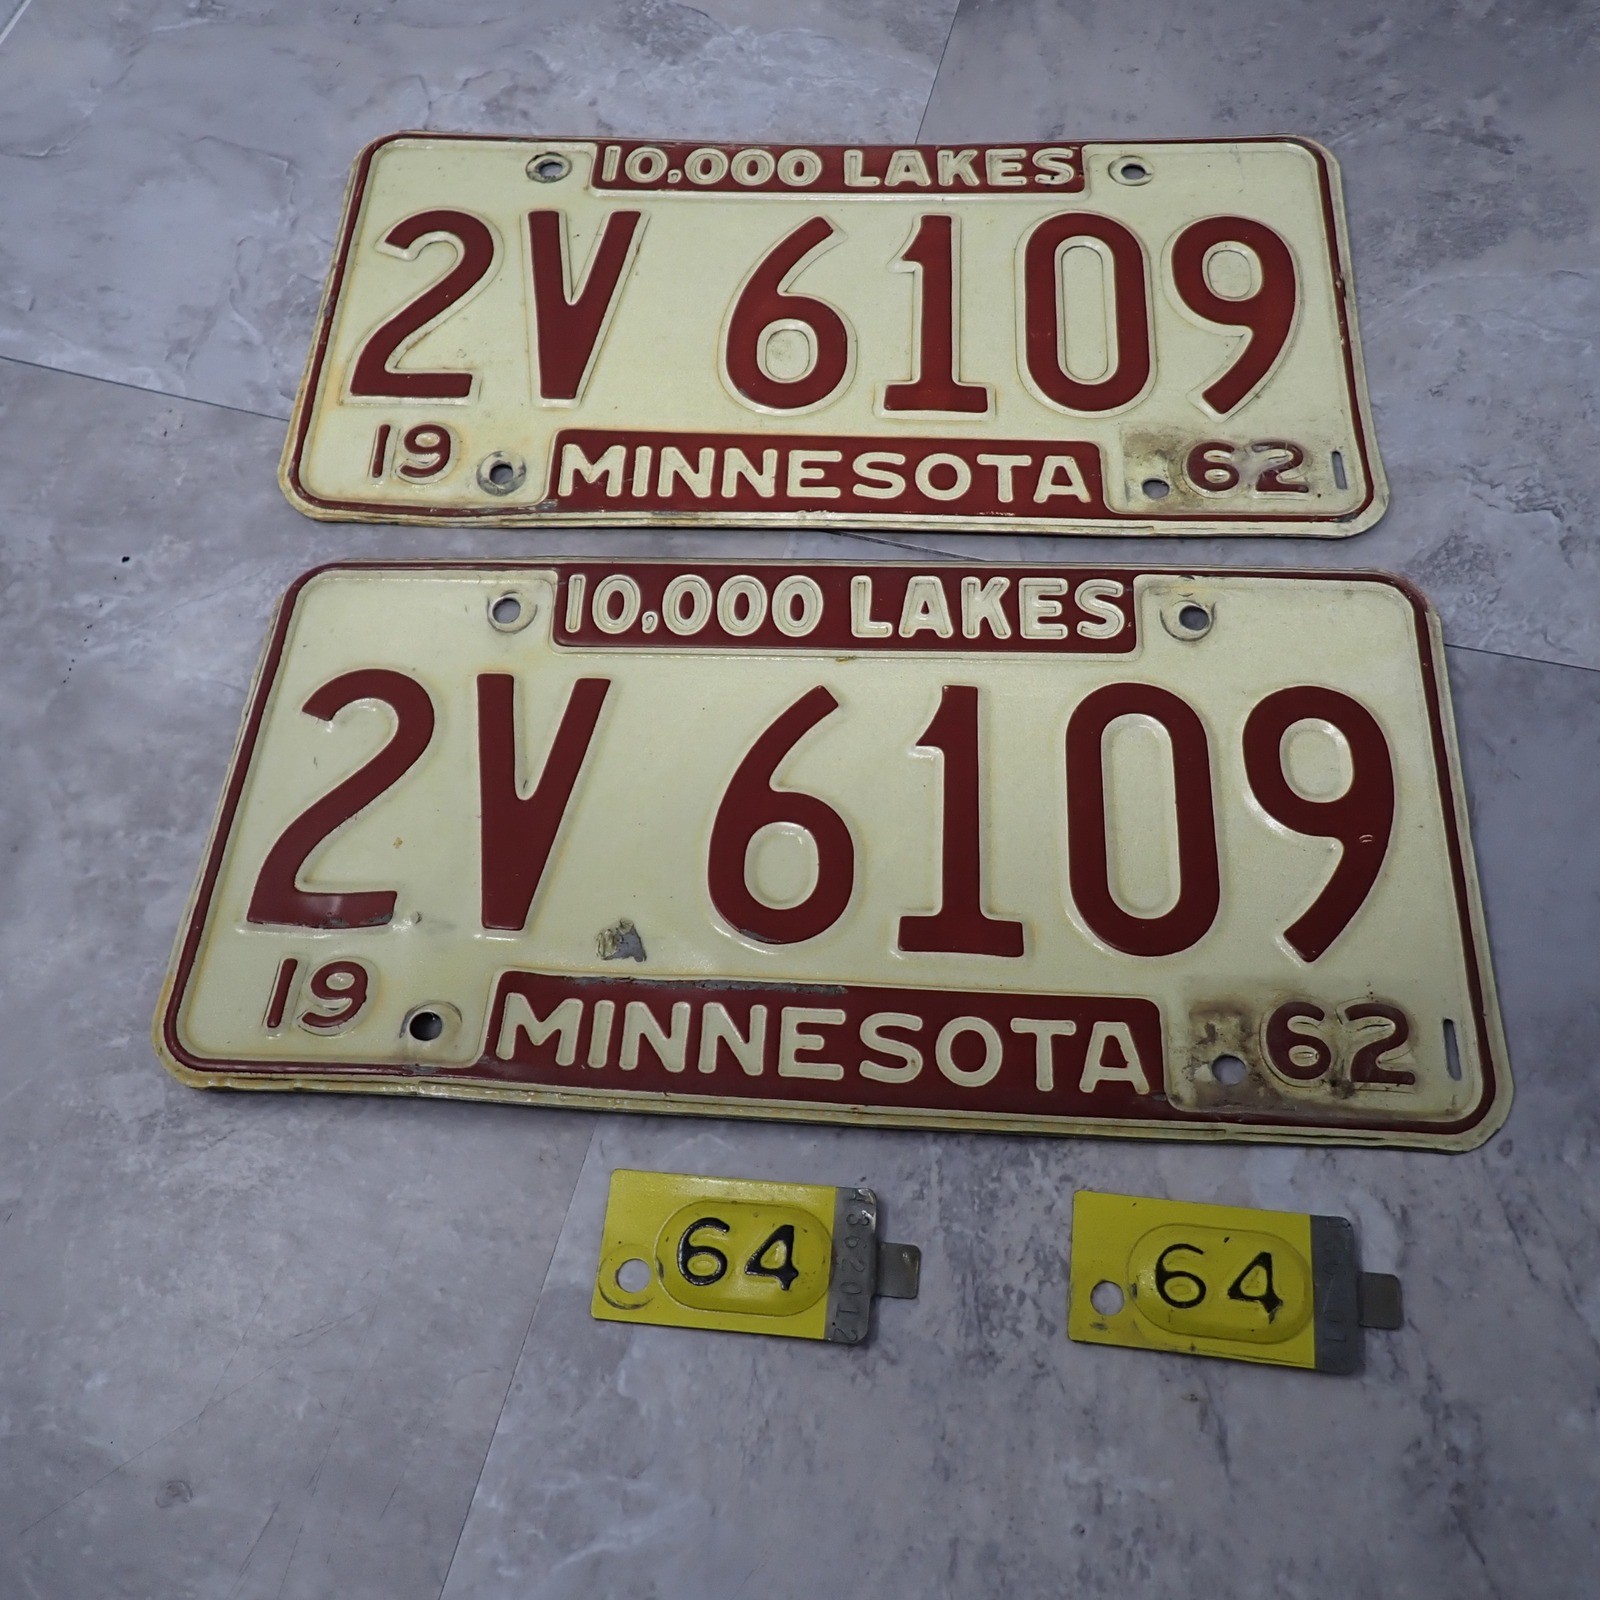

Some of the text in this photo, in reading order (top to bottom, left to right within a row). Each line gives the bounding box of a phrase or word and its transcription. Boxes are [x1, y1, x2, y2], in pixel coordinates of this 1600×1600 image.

[843, 147, 1074, 187] LAKES
[349, 209, 1297, 415] 2V 6109
[371, 423, 451, 479] 19
[557, 443, 1093, 503] MINNESOTA
[1187, 441, 1309, 494] 62
[565, 573, 1125, 639] 10,000 LAKES
[245, 668, 1395, 962] 2V 6109
[265, 957, 369, 1030] 19
[495, 991, 1150, 1093] MINNESOTA
[1265, 1001, 1416, 1086] 62
[677, 1217, 799, 1291] 64
[1155, 1242, 1283, 1323] 64
